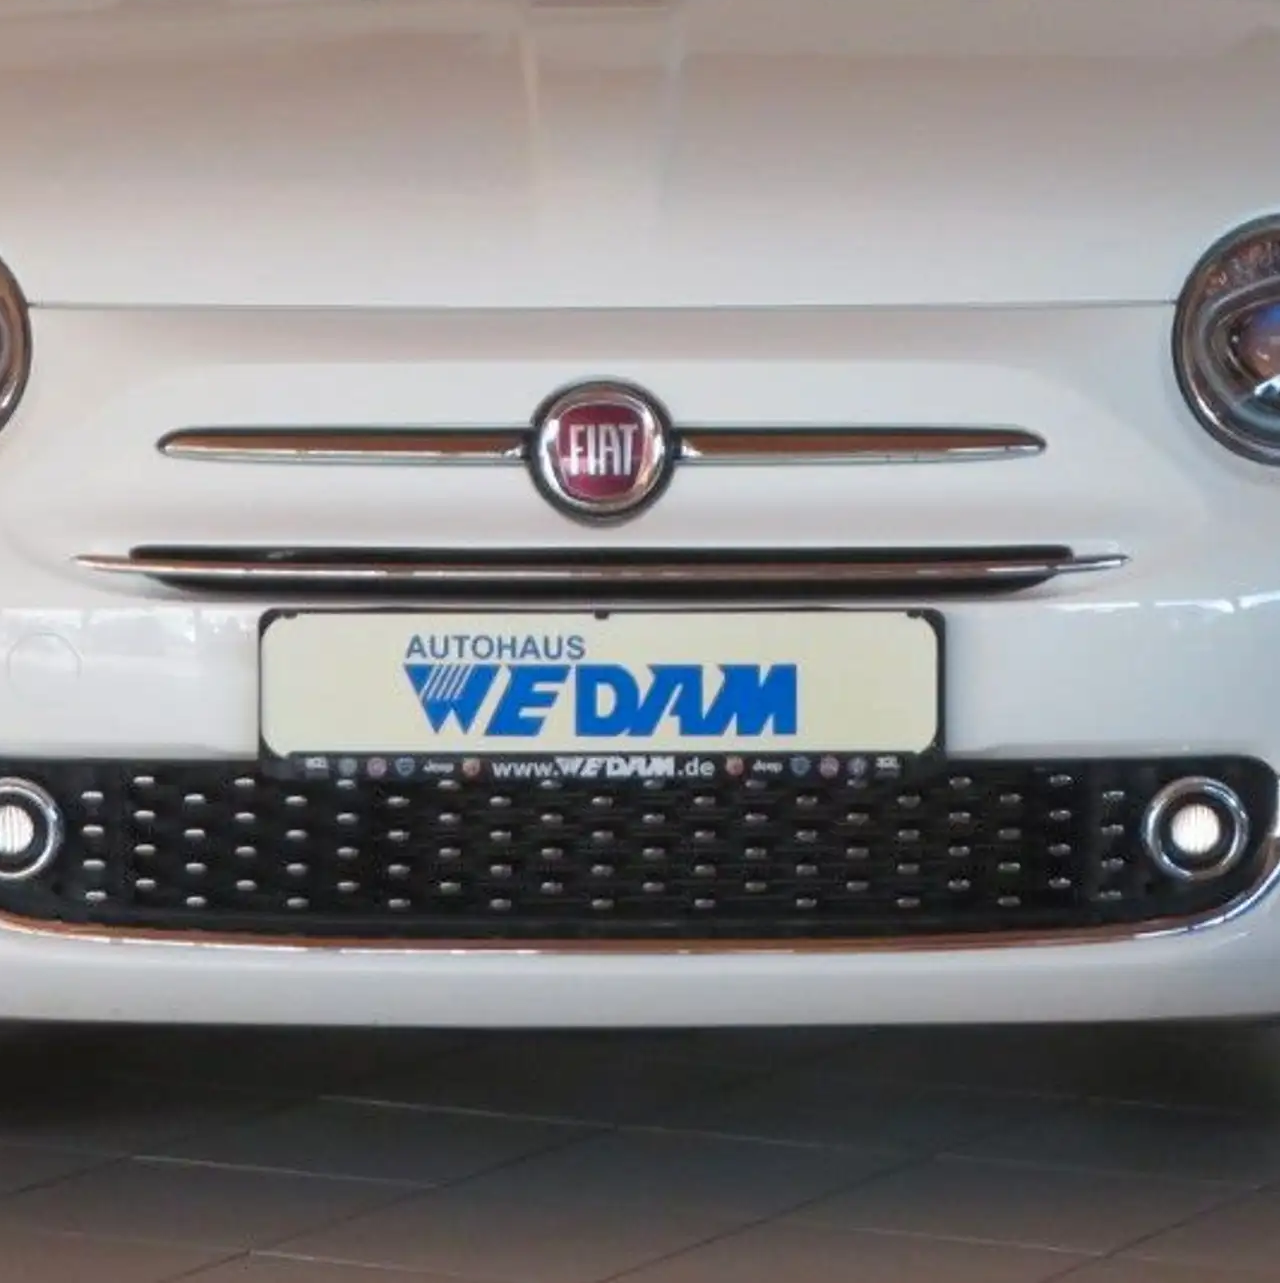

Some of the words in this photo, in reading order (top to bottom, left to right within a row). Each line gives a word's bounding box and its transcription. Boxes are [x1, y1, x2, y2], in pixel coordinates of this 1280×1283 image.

[569, 423, 639, 476] FIAT
[405, 634, 586, 660] AUTOHAUS
[403, 663, 798, 737] WEDAM
[491, 755, 716, 778] www.WEDAM.de
